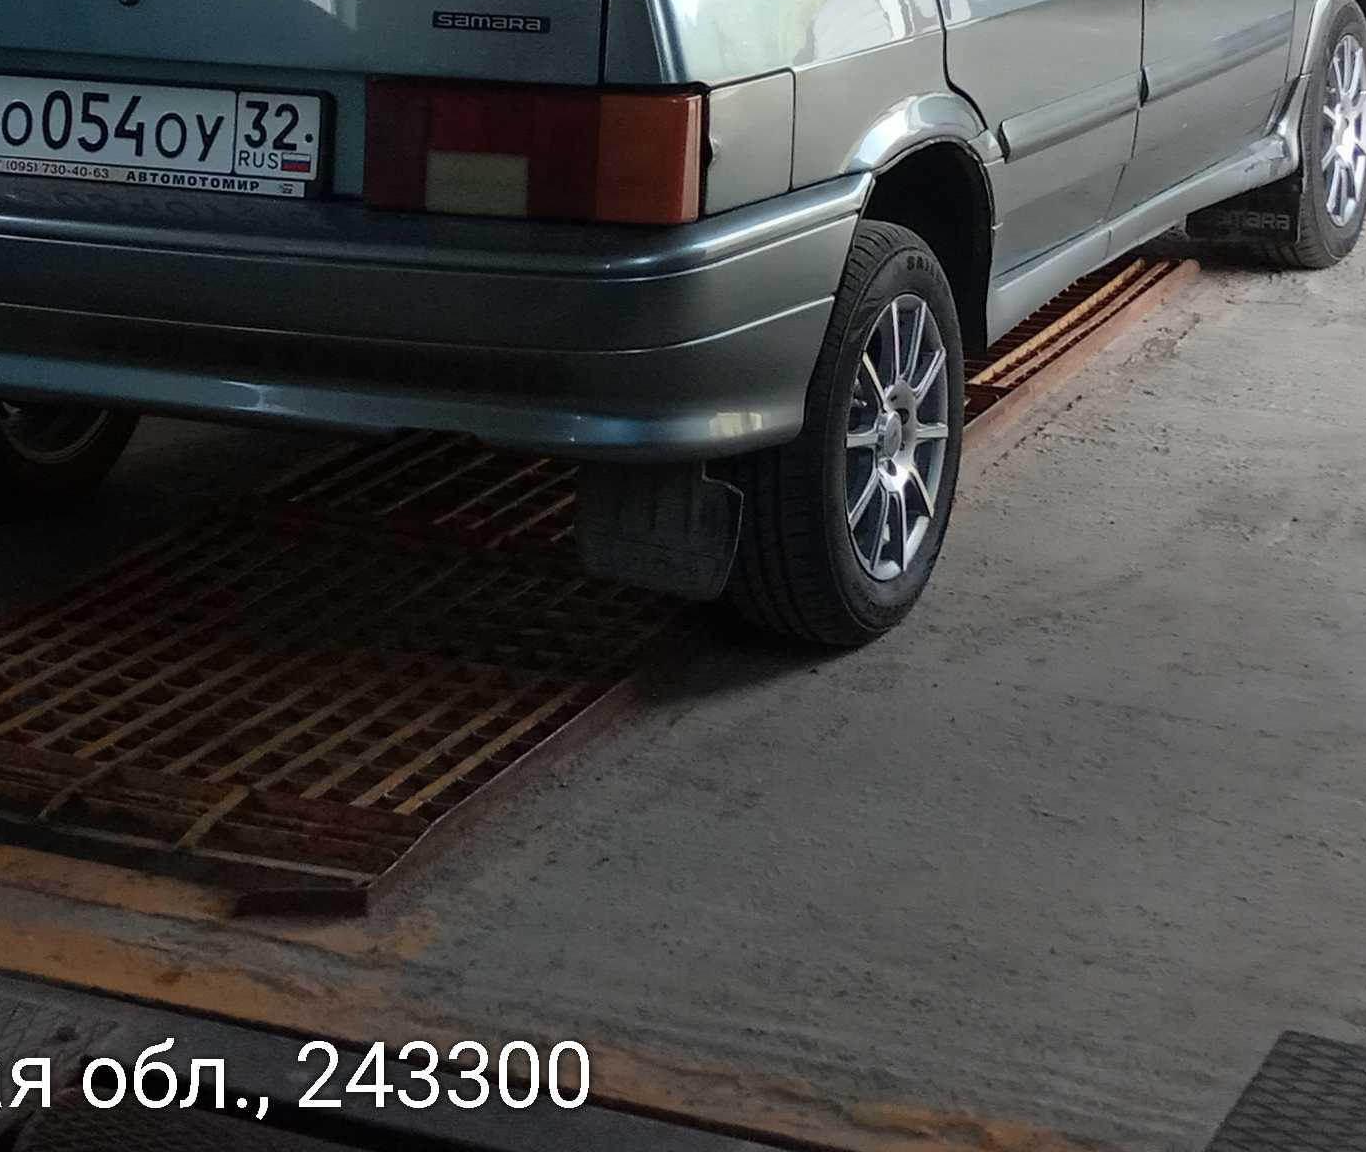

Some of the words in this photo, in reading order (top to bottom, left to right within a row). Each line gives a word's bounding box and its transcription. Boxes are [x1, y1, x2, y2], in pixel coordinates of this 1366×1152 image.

[243, 100, 300, 152] 32
[237, 150, 280, 170] RUS
[126, 170, 260, 192] АВТОМОТОМИР
